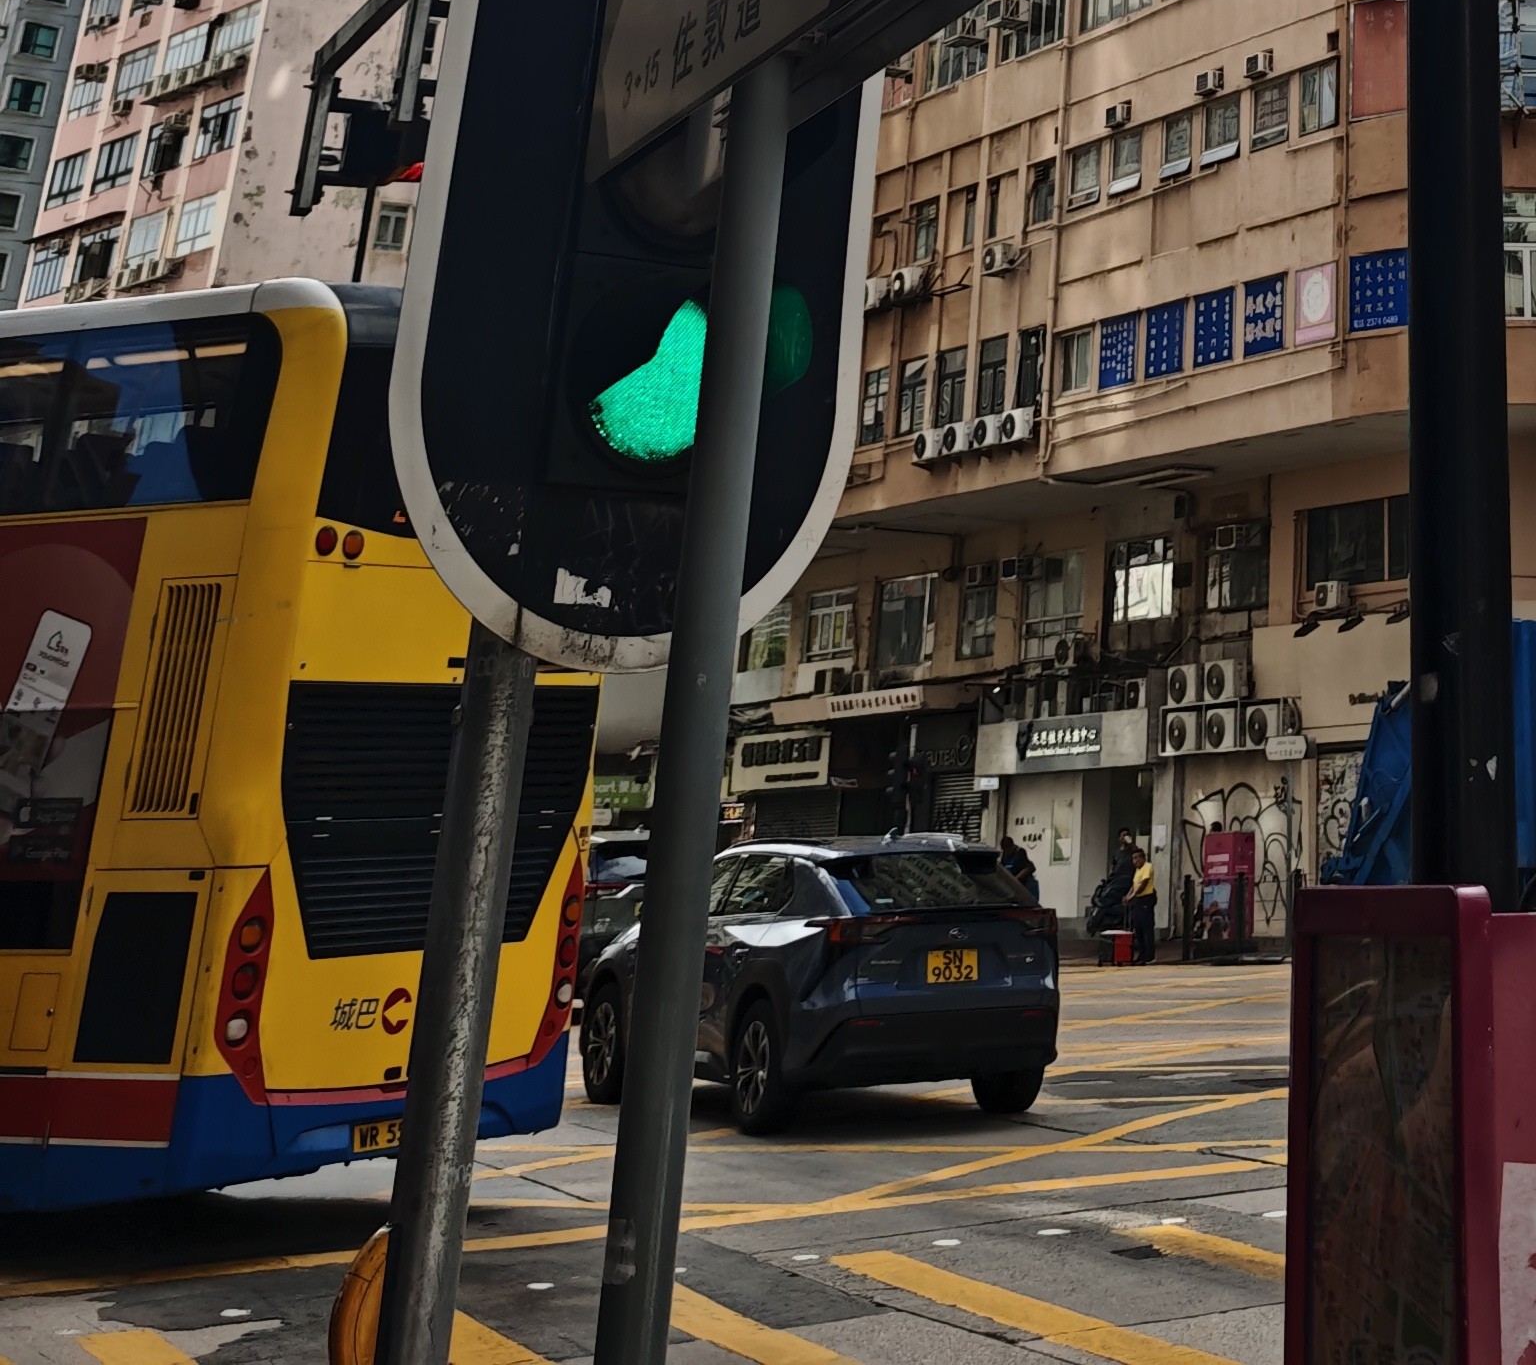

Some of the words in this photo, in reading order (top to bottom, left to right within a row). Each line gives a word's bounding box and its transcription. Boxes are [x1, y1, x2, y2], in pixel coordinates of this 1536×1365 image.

[942, 949, 964, 966] SN
[931, 964, 974, 981] 9032
[330, 998, 380, 1031] 城巴
[358, 1125, 380, 1149] WR
